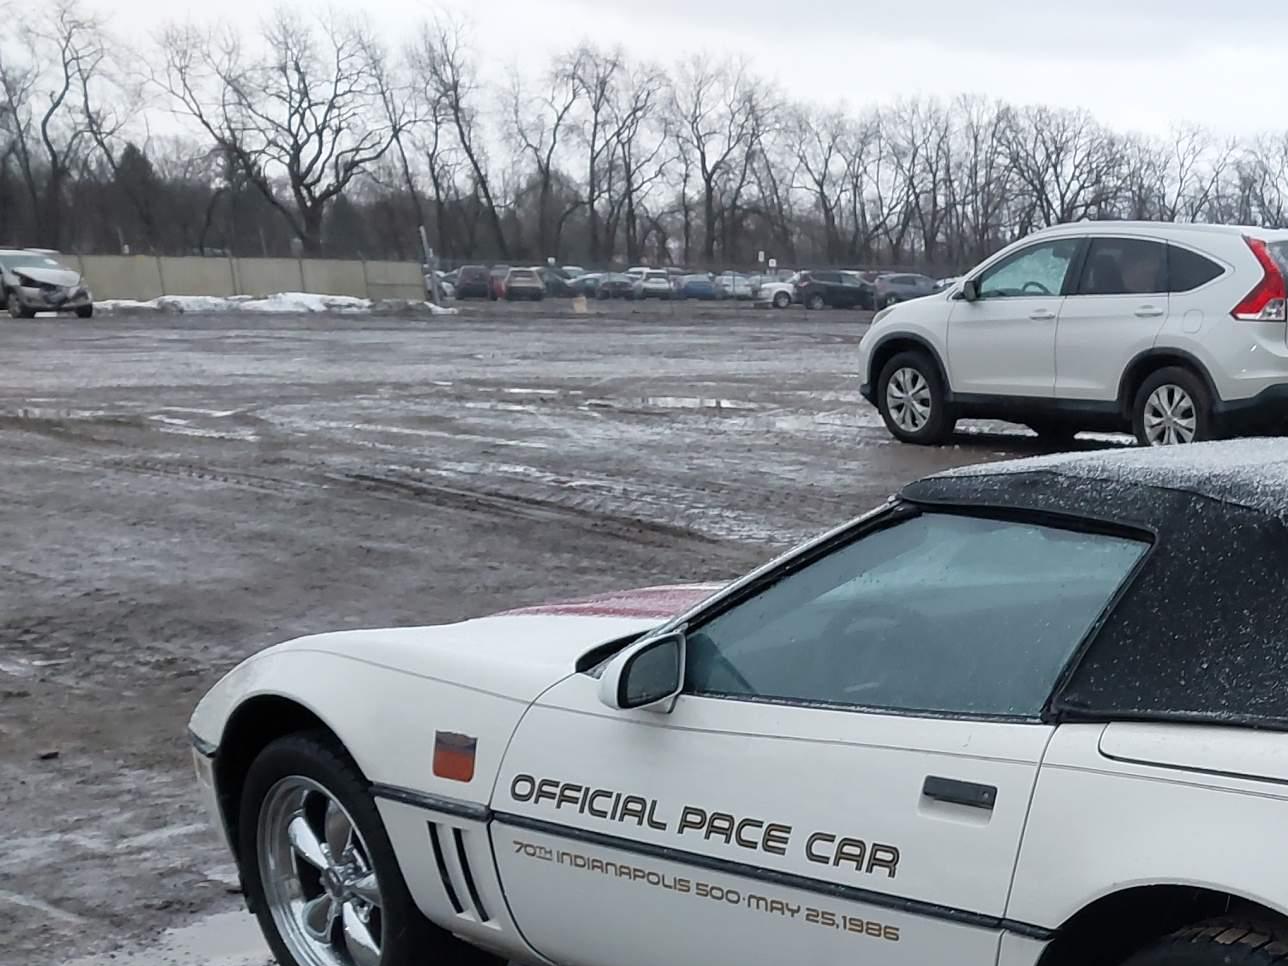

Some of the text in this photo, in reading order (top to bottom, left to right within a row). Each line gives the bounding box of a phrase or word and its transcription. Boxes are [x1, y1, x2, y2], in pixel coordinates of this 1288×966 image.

[511, 774, 900, 878] OFFICIAL PACE CAR
[556, 850, 691, 893] INDIANAPOLIS
